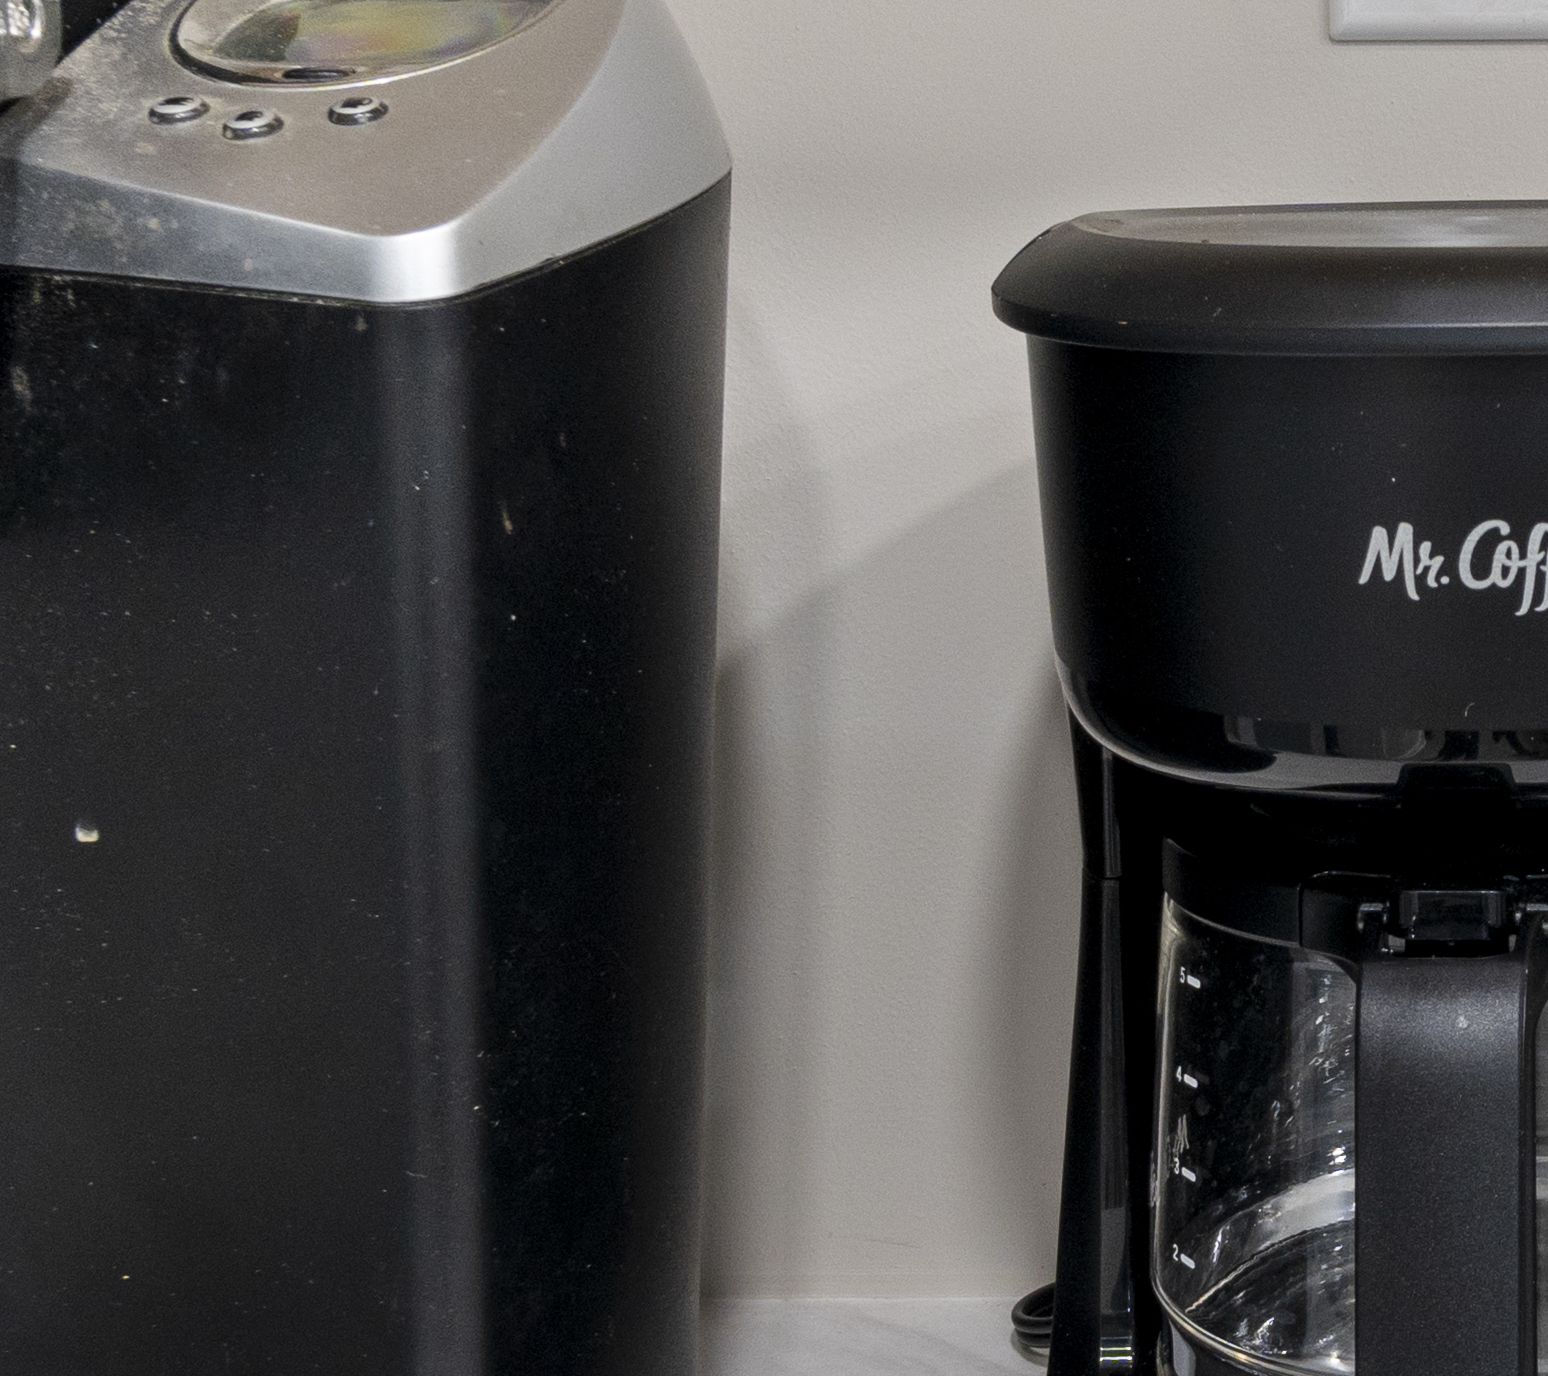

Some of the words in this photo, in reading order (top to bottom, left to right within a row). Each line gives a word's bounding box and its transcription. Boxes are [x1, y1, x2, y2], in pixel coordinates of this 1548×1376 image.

[1357, 522, 1450, 601] Mr.
[1179, 966, 1186, 983] 5
[1176, 1065, 1182, 1082] 4
[1173, 1243, 1179, 1261] 2
